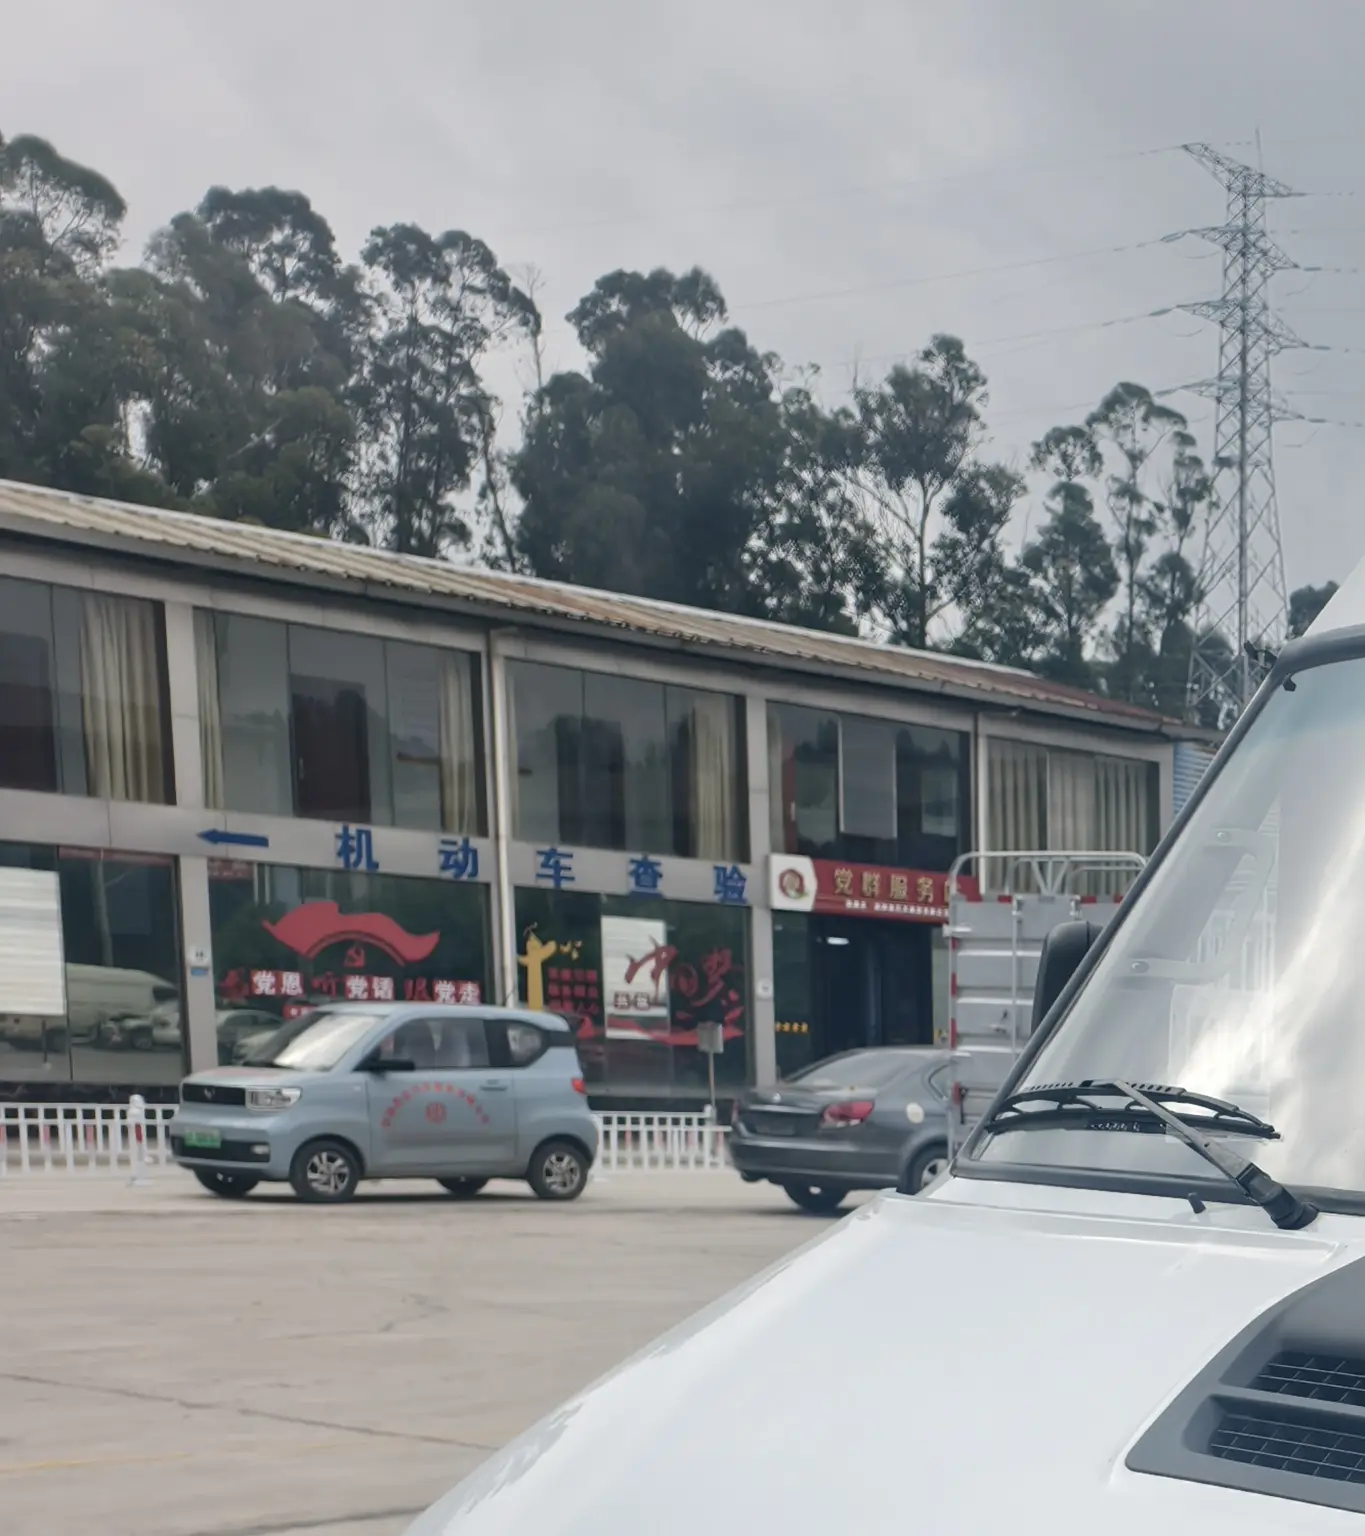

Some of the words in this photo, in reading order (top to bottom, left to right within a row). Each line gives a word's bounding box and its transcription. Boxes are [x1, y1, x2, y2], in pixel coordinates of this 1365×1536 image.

[335, 825, 749, 906] 机动车查验
